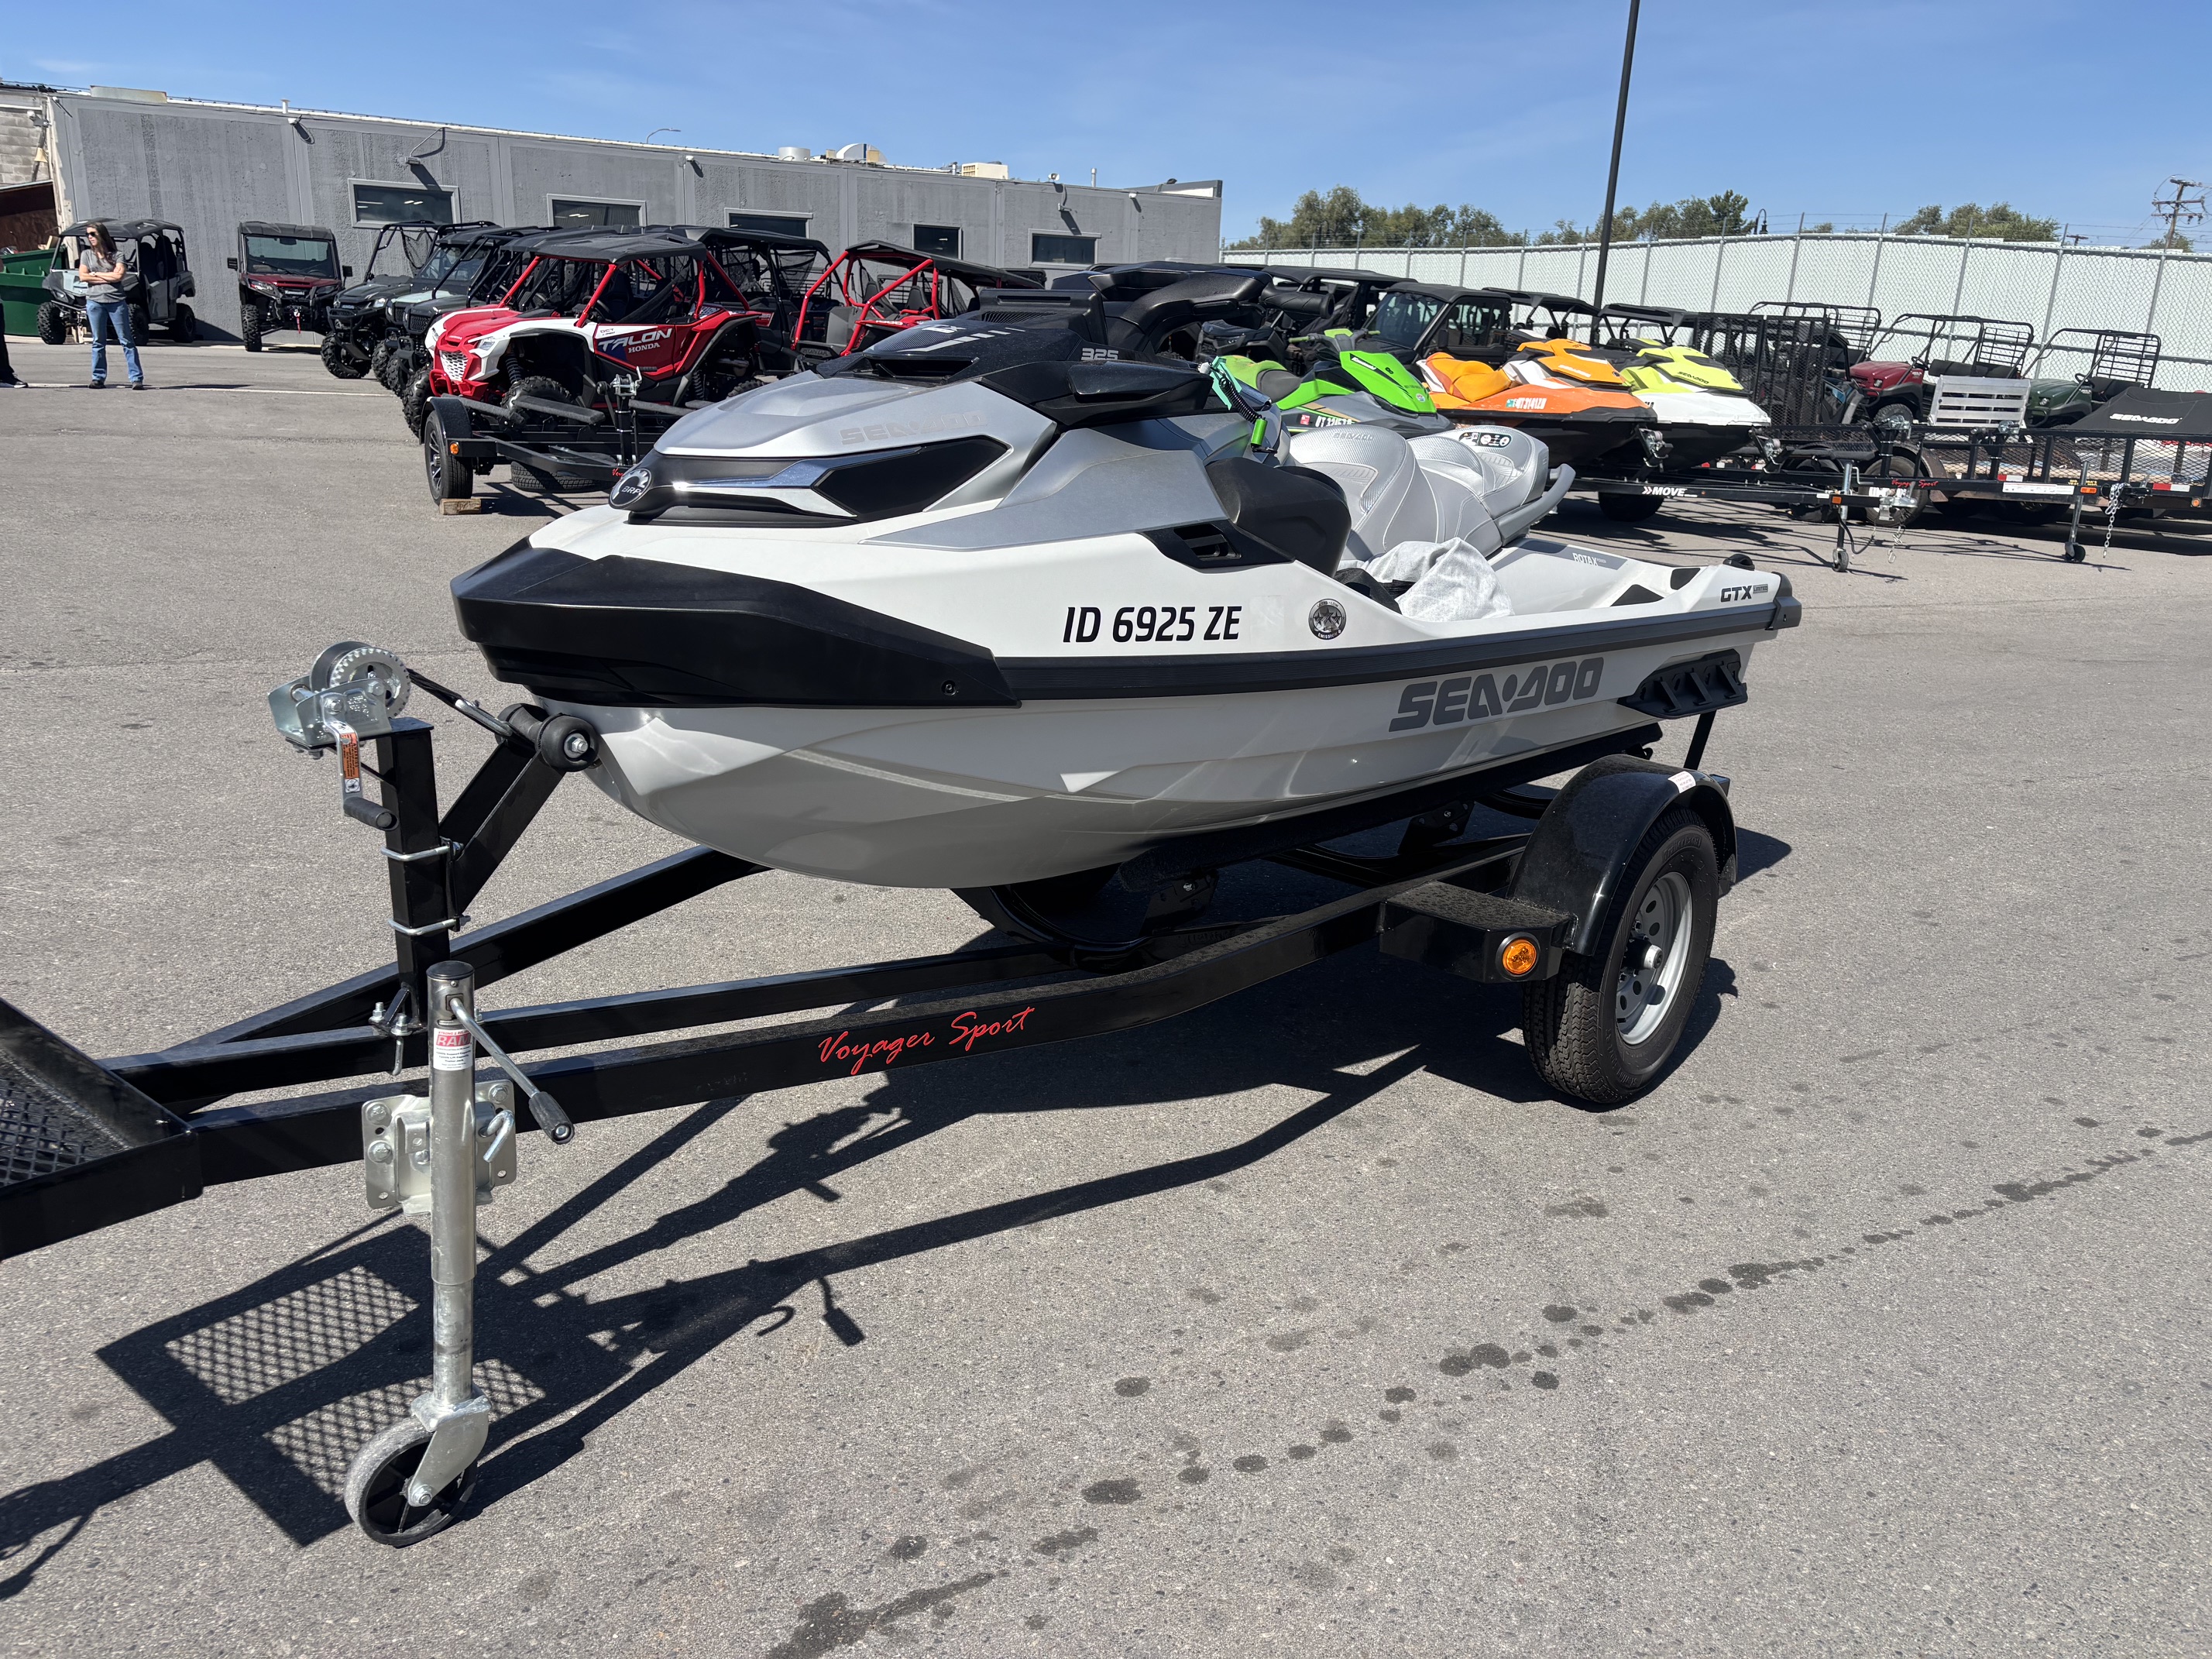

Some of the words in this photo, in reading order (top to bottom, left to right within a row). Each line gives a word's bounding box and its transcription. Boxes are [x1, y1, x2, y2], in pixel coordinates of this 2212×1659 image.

[598, 328, 672, 352] TALON
[628, 342, 661, 353] HONDA
[1081, 348, 1118, 360] 325
[621, 486, 641, 495] BRP
[1652, 486, 1686, 497] MOVE
[1572, 552, 1599, 566] ROTAX
[1721, 586, 1752, 602] GTX
[1063, 606, 1101, 643] ID
[1113, 606, 1196, 643] 6925
[1203, 606, 1242, 641] ZE
[437, 1035, 472, 1046] RAM
[818, 1031, 935, 1075] Voyager
[949, 1006, 1035, 1051] Sport
